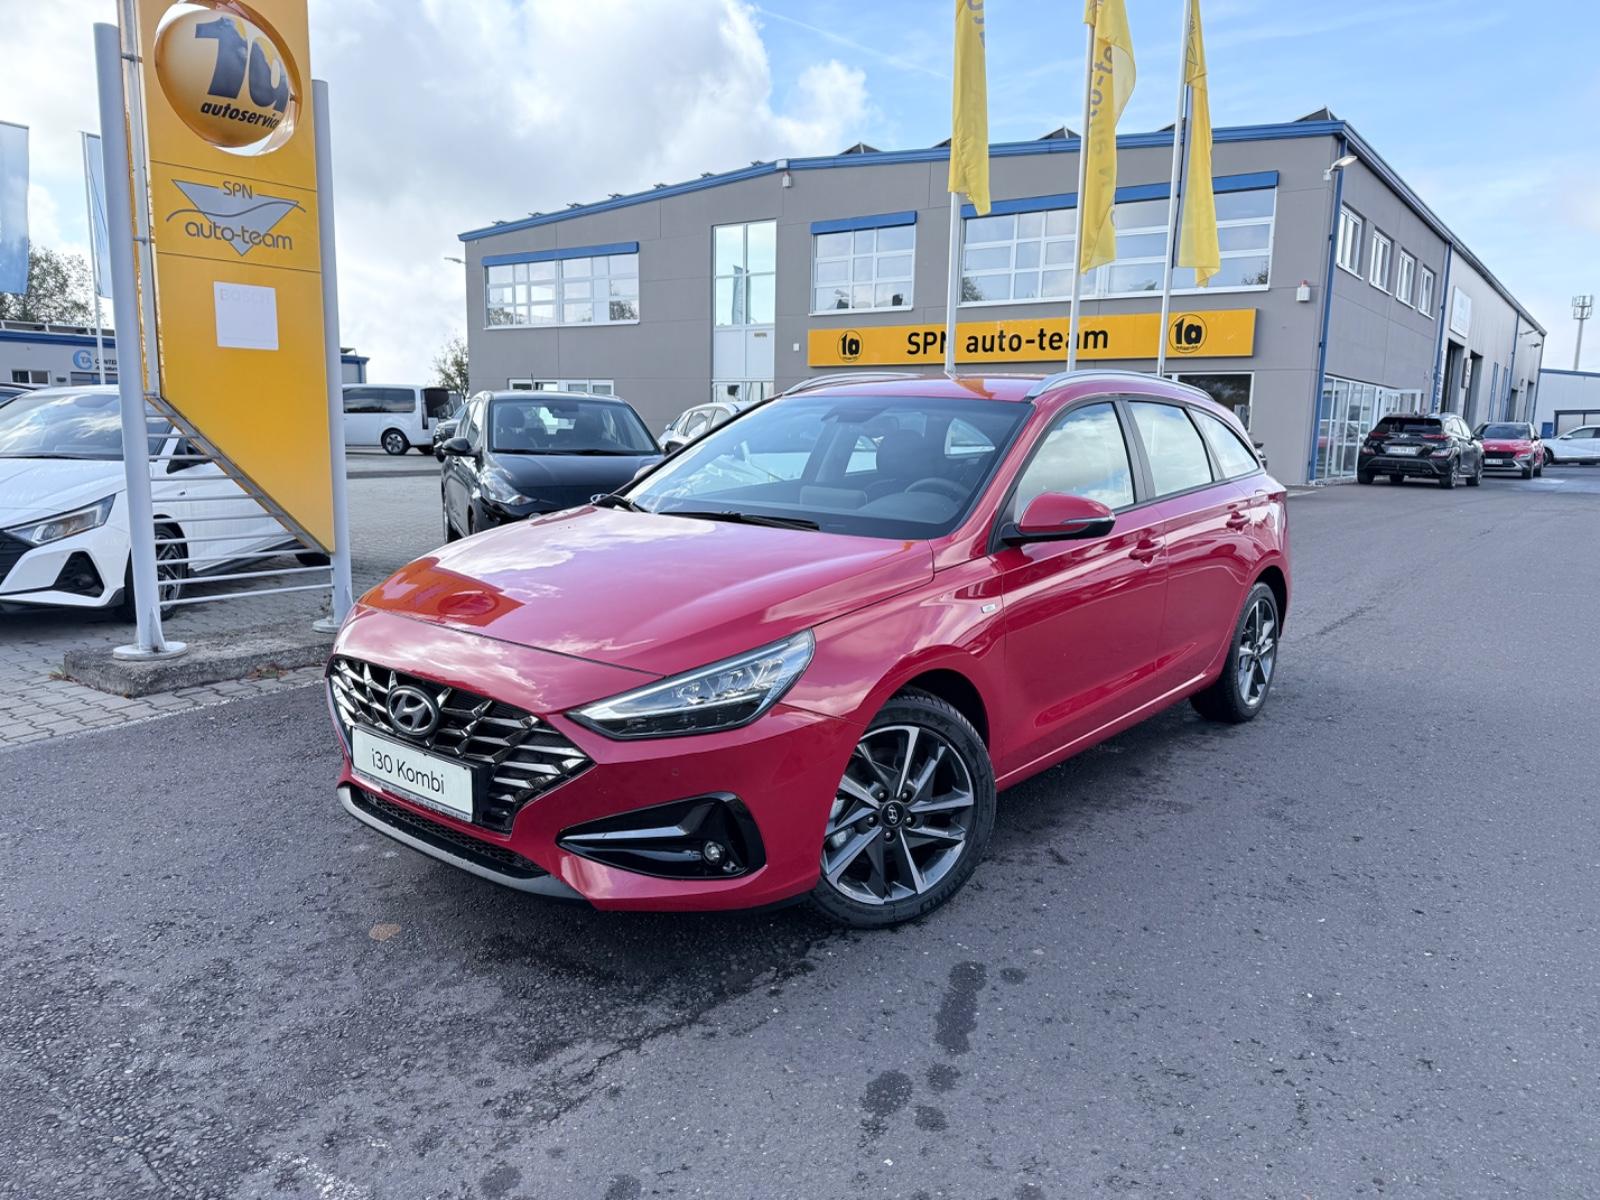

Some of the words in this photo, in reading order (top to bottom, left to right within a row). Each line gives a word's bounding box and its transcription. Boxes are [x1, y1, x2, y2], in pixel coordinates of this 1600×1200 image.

[222, 181, 253, 200] SPN
[185, 221, 293, 250] auto-team
[371, 748, 393, 774] i30
[397, 758, 445, 795] Kombi
